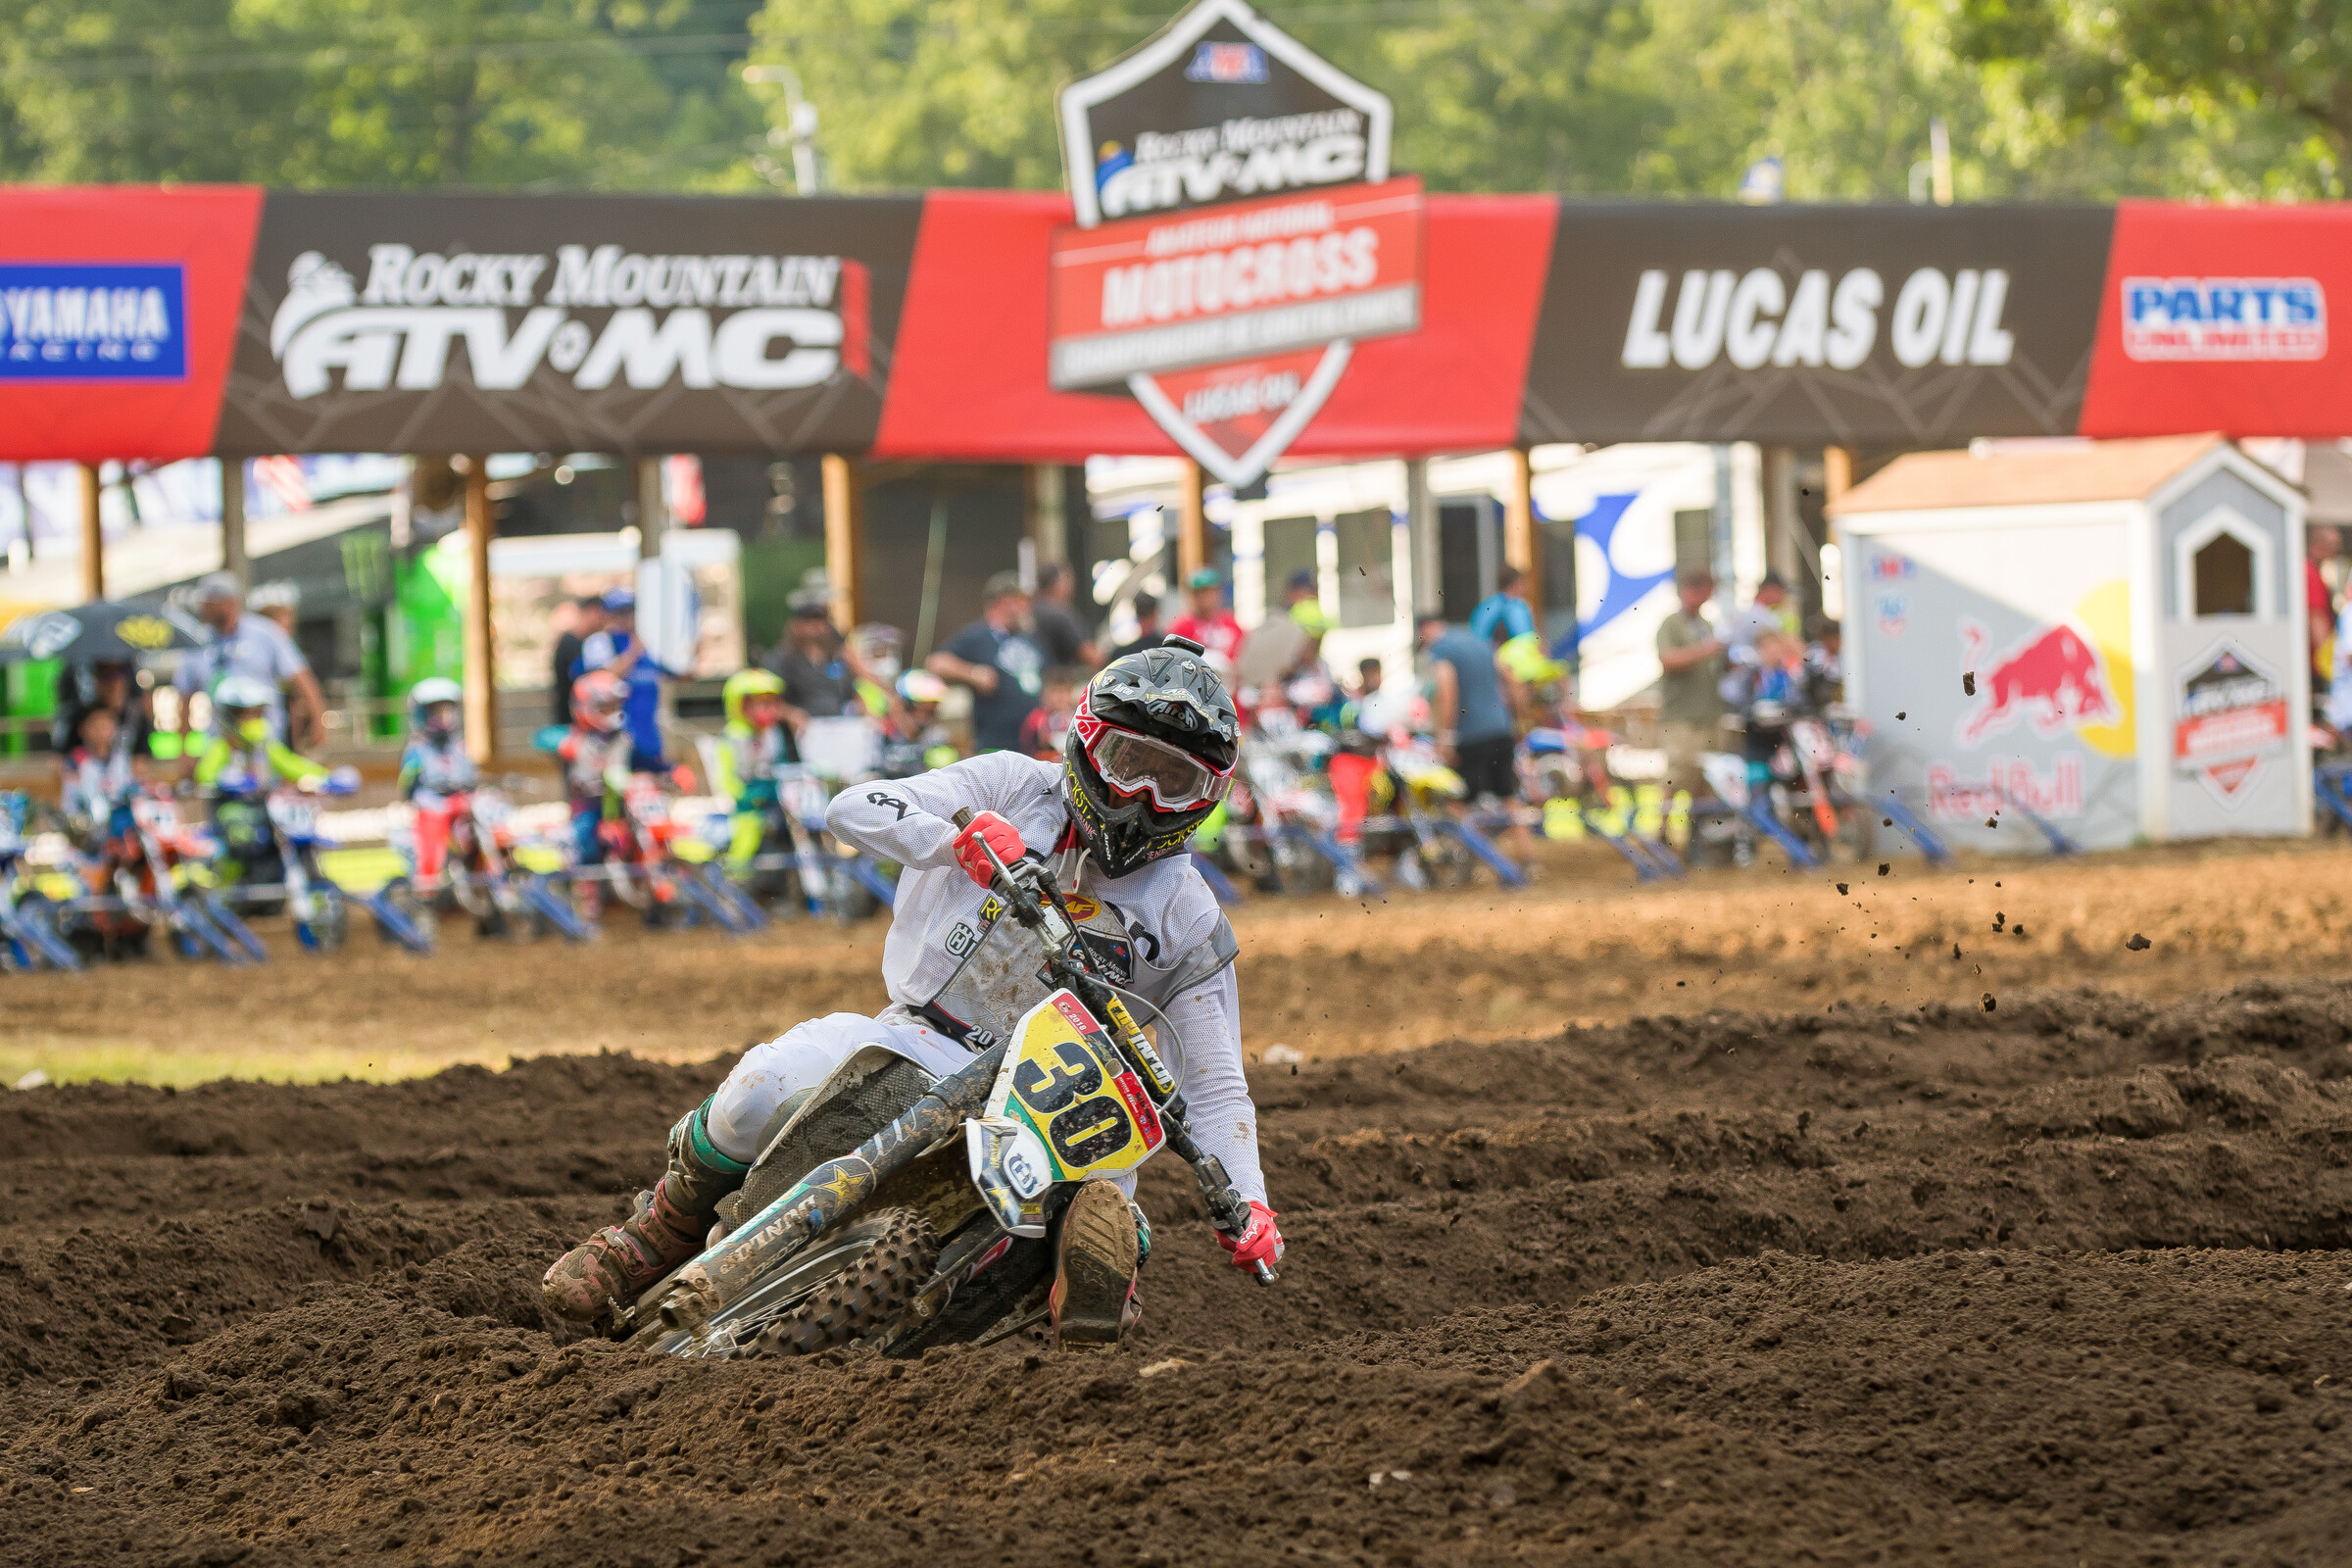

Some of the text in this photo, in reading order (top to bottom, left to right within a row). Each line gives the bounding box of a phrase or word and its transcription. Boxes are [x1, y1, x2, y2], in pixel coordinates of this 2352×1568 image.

[362, 244, 841, 309] ROCKY MOUNTAIN
[1101, 226, 1380, 328] MOTOCROSS
[2130, 286, 2319, 325] PARTS
[3, 285, 172, 343] YAMAHA
[1622, 268, 2014, 369] LUCAS OIL
[1150, 702, 1195, 728] Airoh
[1068, 1012, 1088, 1032] 2018
[1011, 1041, 1132, 1170] 30
